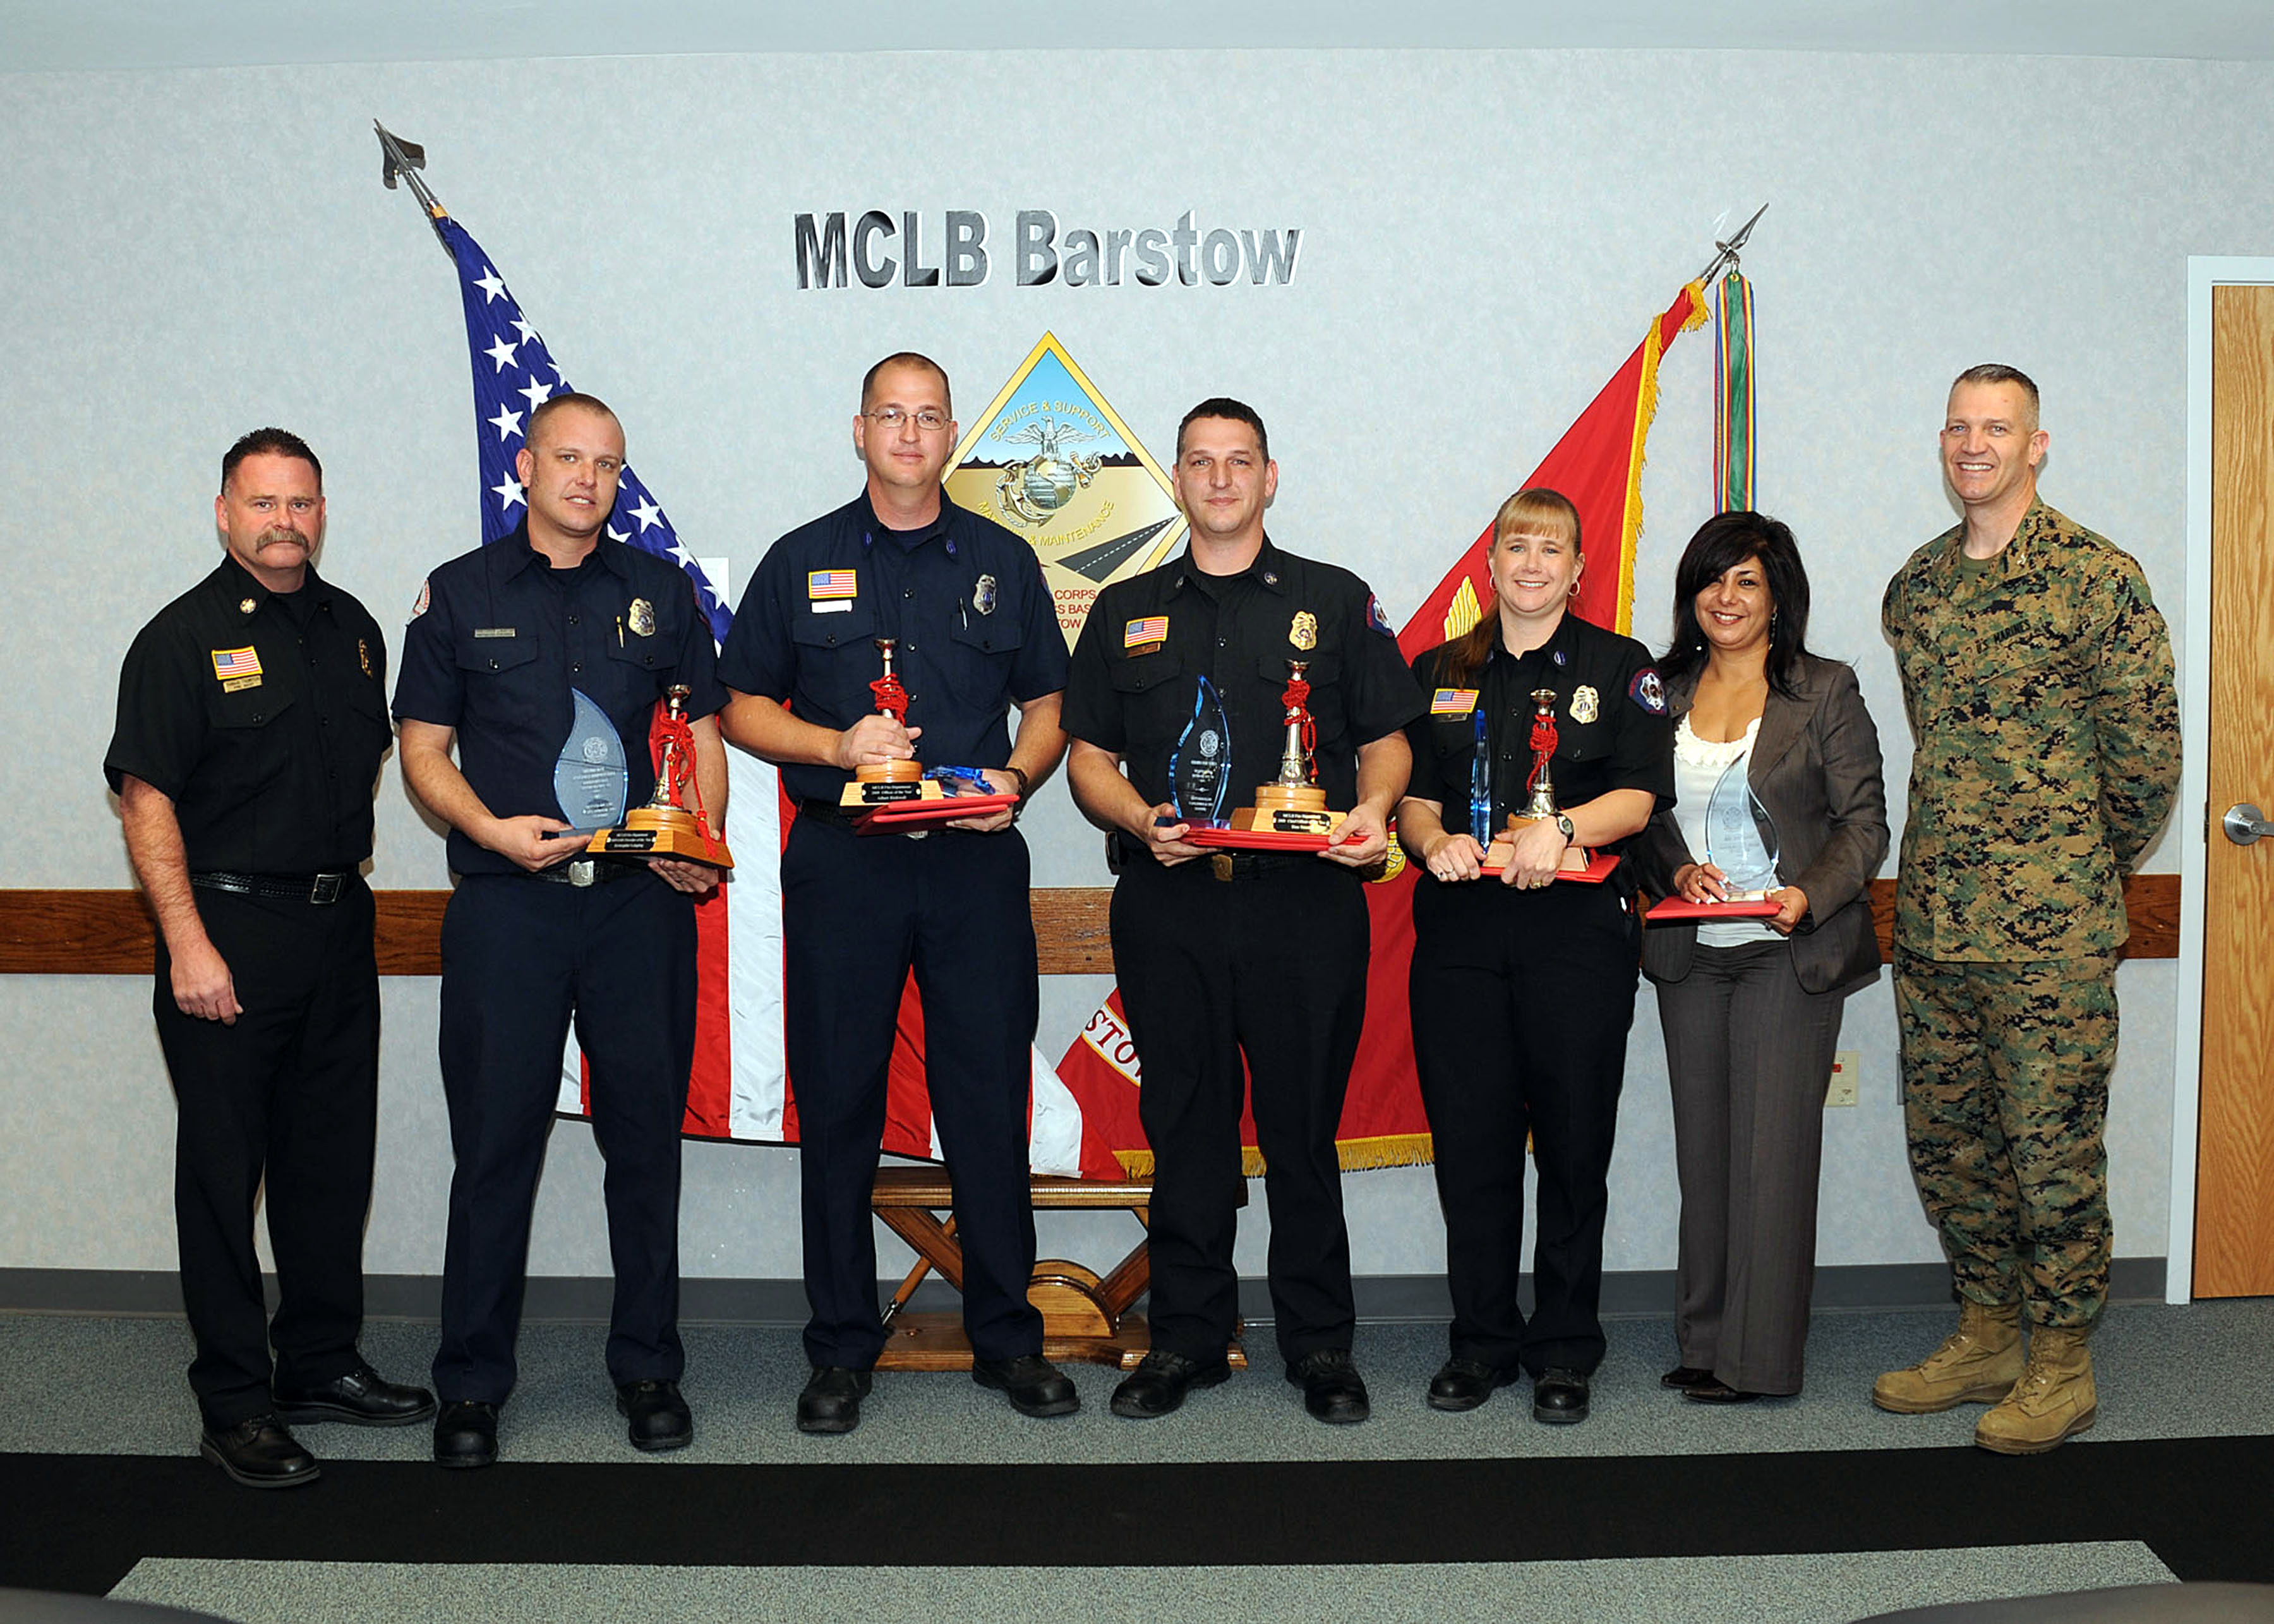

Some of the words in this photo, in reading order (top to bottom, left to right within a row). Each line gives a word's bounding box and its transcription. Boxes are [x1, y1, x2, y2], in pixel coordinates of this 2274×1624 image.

[794, 210, 989, 290] MCLB
[1016, 208, 1303, 287] Barstow
[990, 401, 1040, 442] SERVICE
[1042, 400, 1052, 412] &
[1054, 400, 1111, 440] SUPPORT
[1039, 500, 1115, 546] MAINTENANCE
[1054, 589, 1097, 600] CORPS
[1055, 604, 1066, 615] S
[1068, 603, 1092, 615] BAS
[1058, 618, 1082, 629] OW
[1993, 619, 2031, 644] MARINES
[1085, 1009, 1142, 1078] STO
